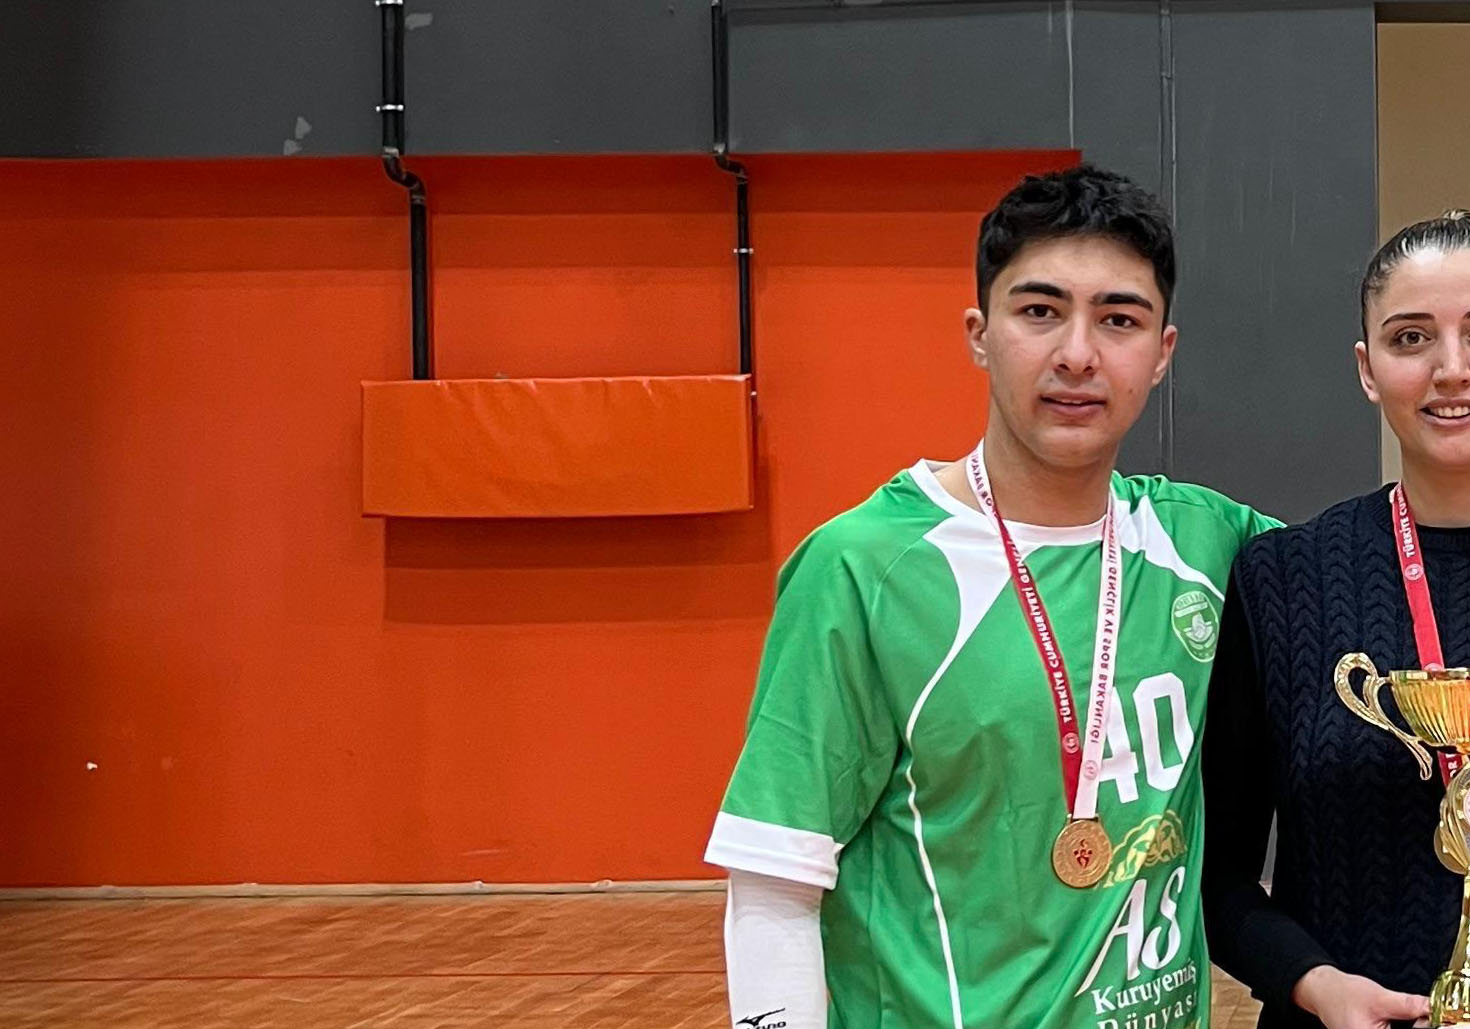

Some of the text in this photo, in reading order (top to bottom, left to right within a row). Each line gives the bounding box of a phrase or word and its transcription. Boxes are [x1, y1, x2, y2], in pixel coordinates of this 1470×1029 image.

[1021, 586, 1060, 669] CUMHURİYETİ
[1053, 671, 1073, 724] TÜRKİYE
[1098, 672, 1194, 804] 40
